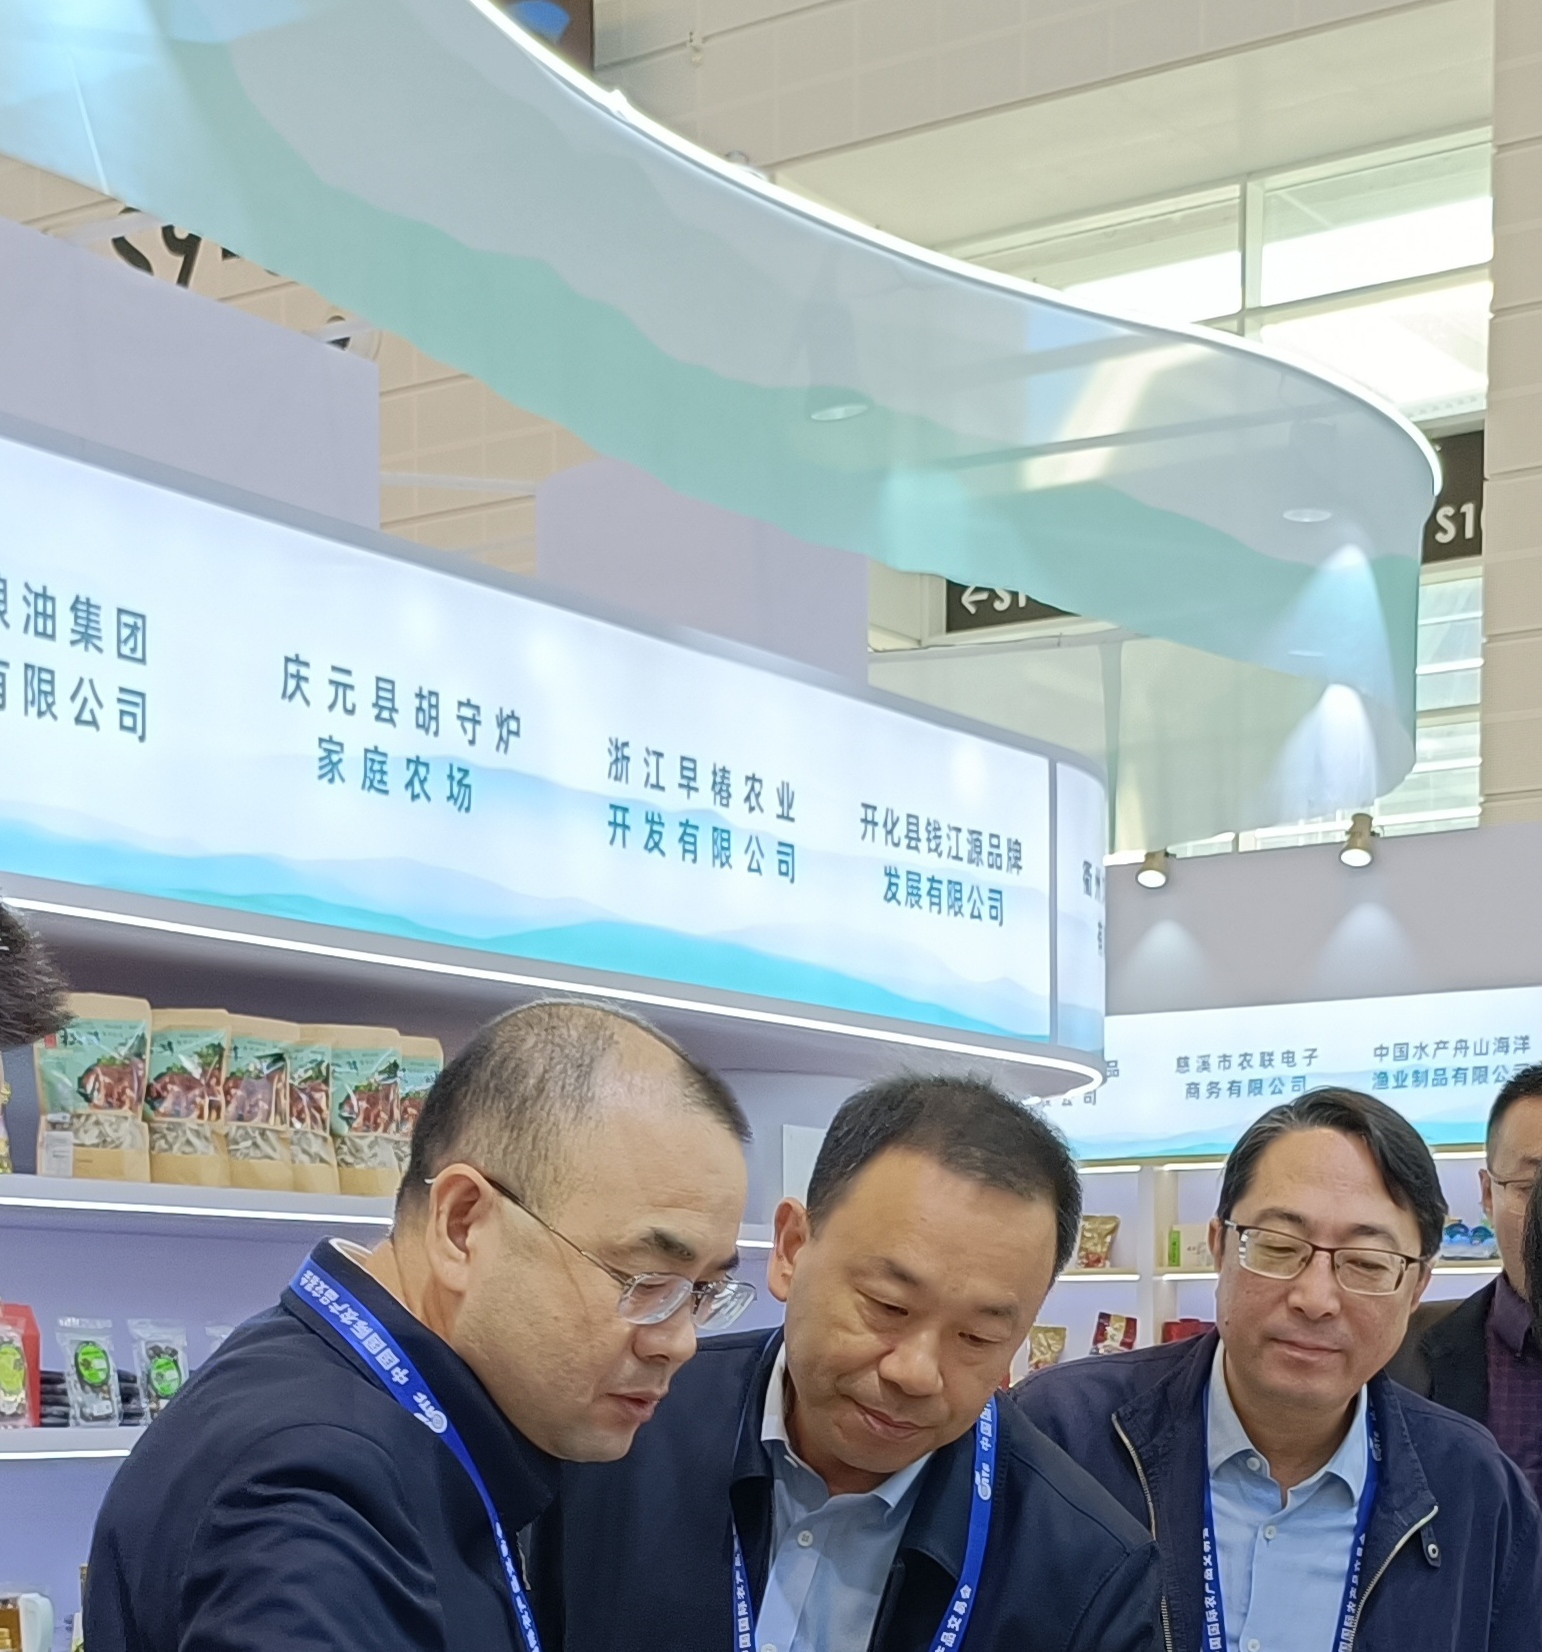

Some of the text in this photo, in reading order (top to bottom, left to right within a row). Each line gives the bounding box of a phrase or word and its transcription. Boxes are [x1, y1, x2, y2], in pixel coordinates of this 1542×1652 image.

[281, 653, 521, 755] 庆元县胡守炉
[317, 735, 474, 814] 家庭农场
[607, 738, 796, 823] 浙江早椿农业
[607, 803, 796, 885] 开发有限公司
[860, 803, 1023, 876] 开化县钱江源品牌
[883, 865, 1004, 927] 发展有限公司
[1175, 1047, 1319, 1075] 慈溪市农联电子
[1373, 1034, 1532, 1062] 中国水产舟山海洋
[1185, 1075, 1308, 1101] 商务有限公司
